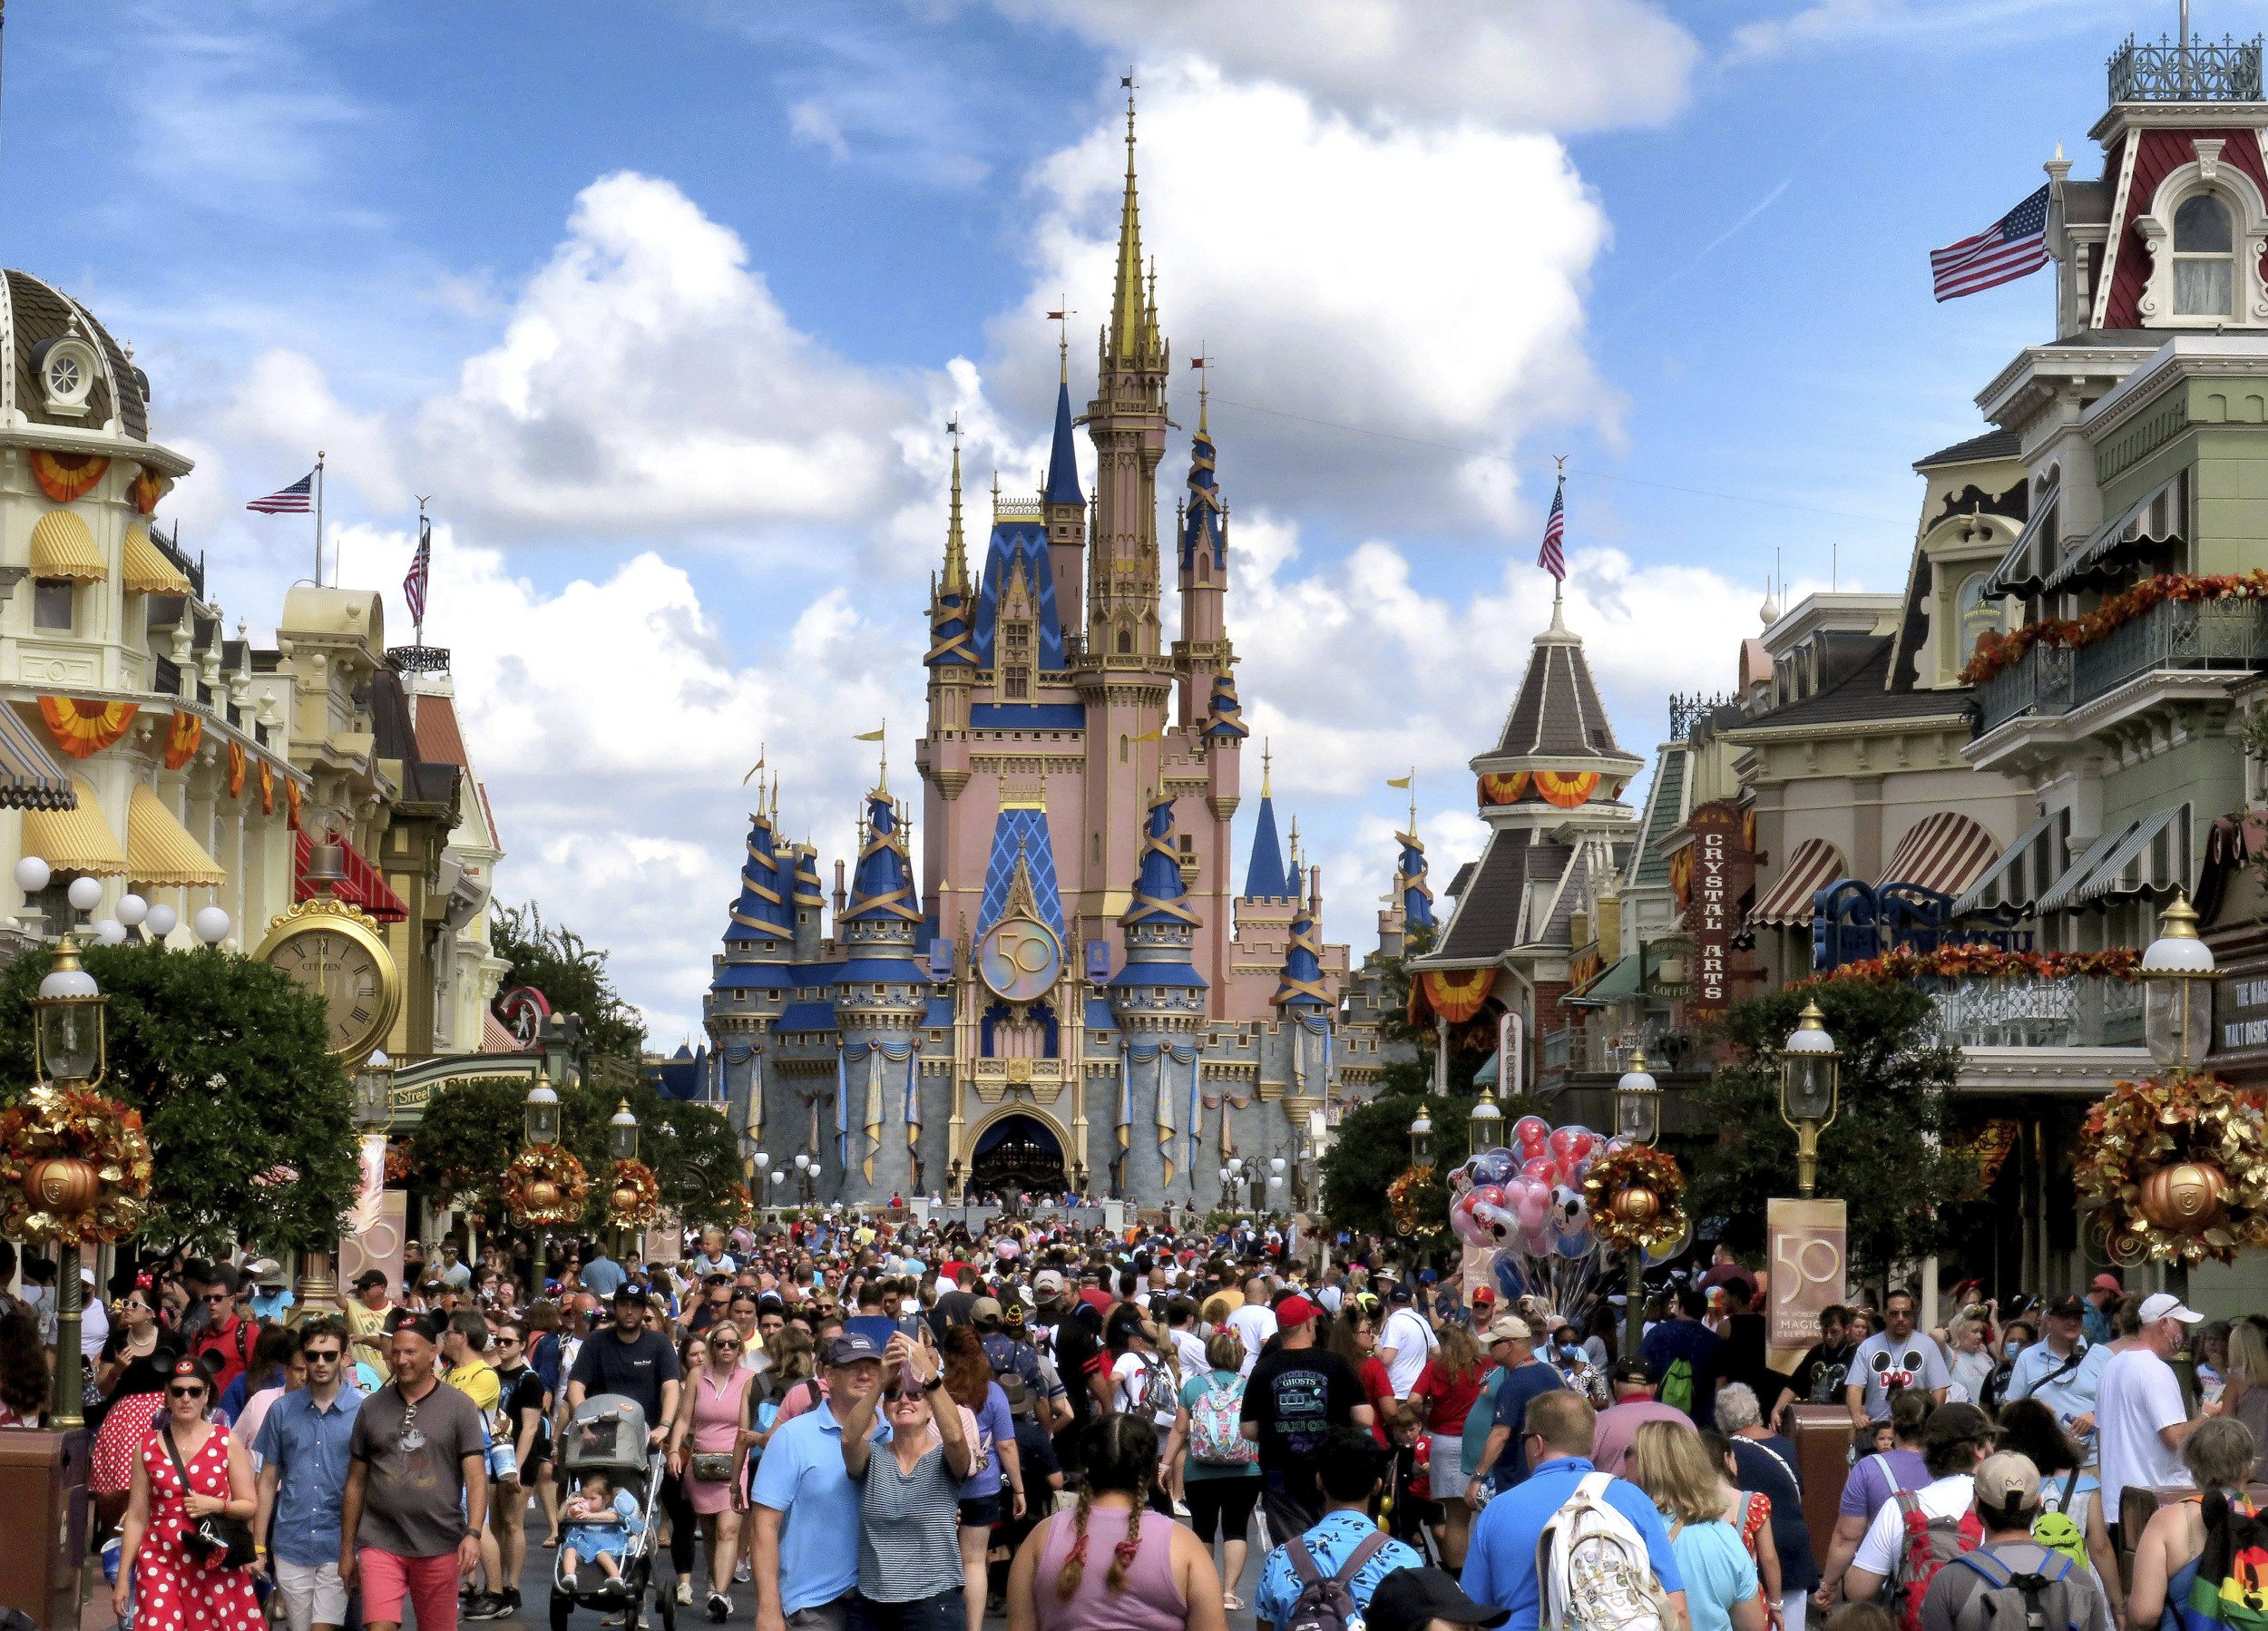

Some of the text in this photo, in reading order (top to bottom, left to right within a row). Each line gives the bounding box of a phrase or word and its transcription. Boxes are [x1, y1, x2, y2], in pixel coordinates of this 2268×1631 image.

[1703, 834, 1724, 999] CRYSTAL ARTS
[301, 962, 341, 972] CITZEN
[999, 933, 1051, 991] 50
[1653, 984, 1693, 997] COFFEE
[398, 1086, 431, 1104] Street
[1777, 1234, 1840, 1304] 50
[1282, 1378, 1316, 1387] GHOSTS
[1880, 1371, 1913, 1387] DAD
[1275, 1421, 1305, 1432] TAXI
